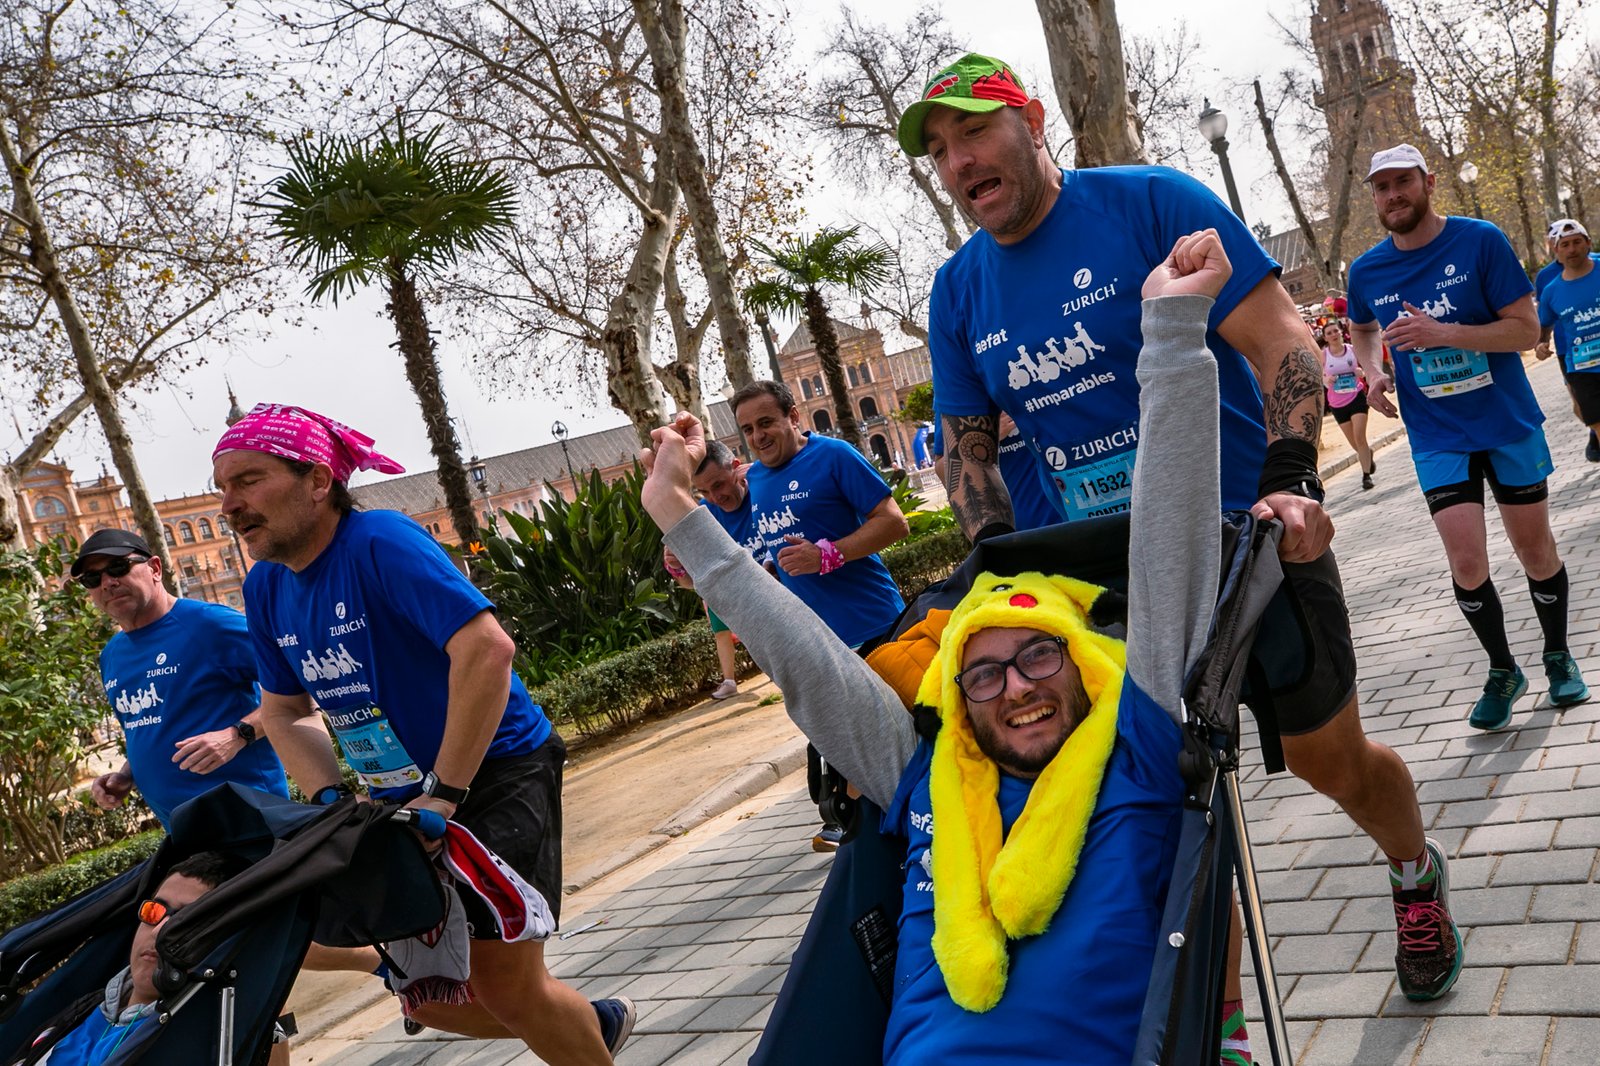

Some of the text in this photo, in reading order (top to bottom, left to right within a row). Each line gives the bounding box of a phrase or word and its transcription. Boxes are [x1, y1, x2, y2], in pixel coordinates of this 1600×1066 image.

[1436, 274, 1467, 290] ZURICH
[1062, 284, 1116, 316] ZURICH
[1374, 293, 1399, 306] aefat
[975, 328, 1008, 355] aefat
[1432, 354, 1463, 368] 11419
[1025, 371, 1116, 413] #Imparables
[1071, 427, 1138, 460] ZURICH
[1080, 471, 1130, 498] 11532
[781, 491, 809, 502] ZURICH
[329, 618, 366, 637] ZURICH
[276, 633, 299, 648] aefat
[146, 666, 177, 678] ZURICH
[316, 681, 371, 700] #Imparables
[330, 707, 374, 727] ZURICH
[910, 811, 934, 835] aefa
